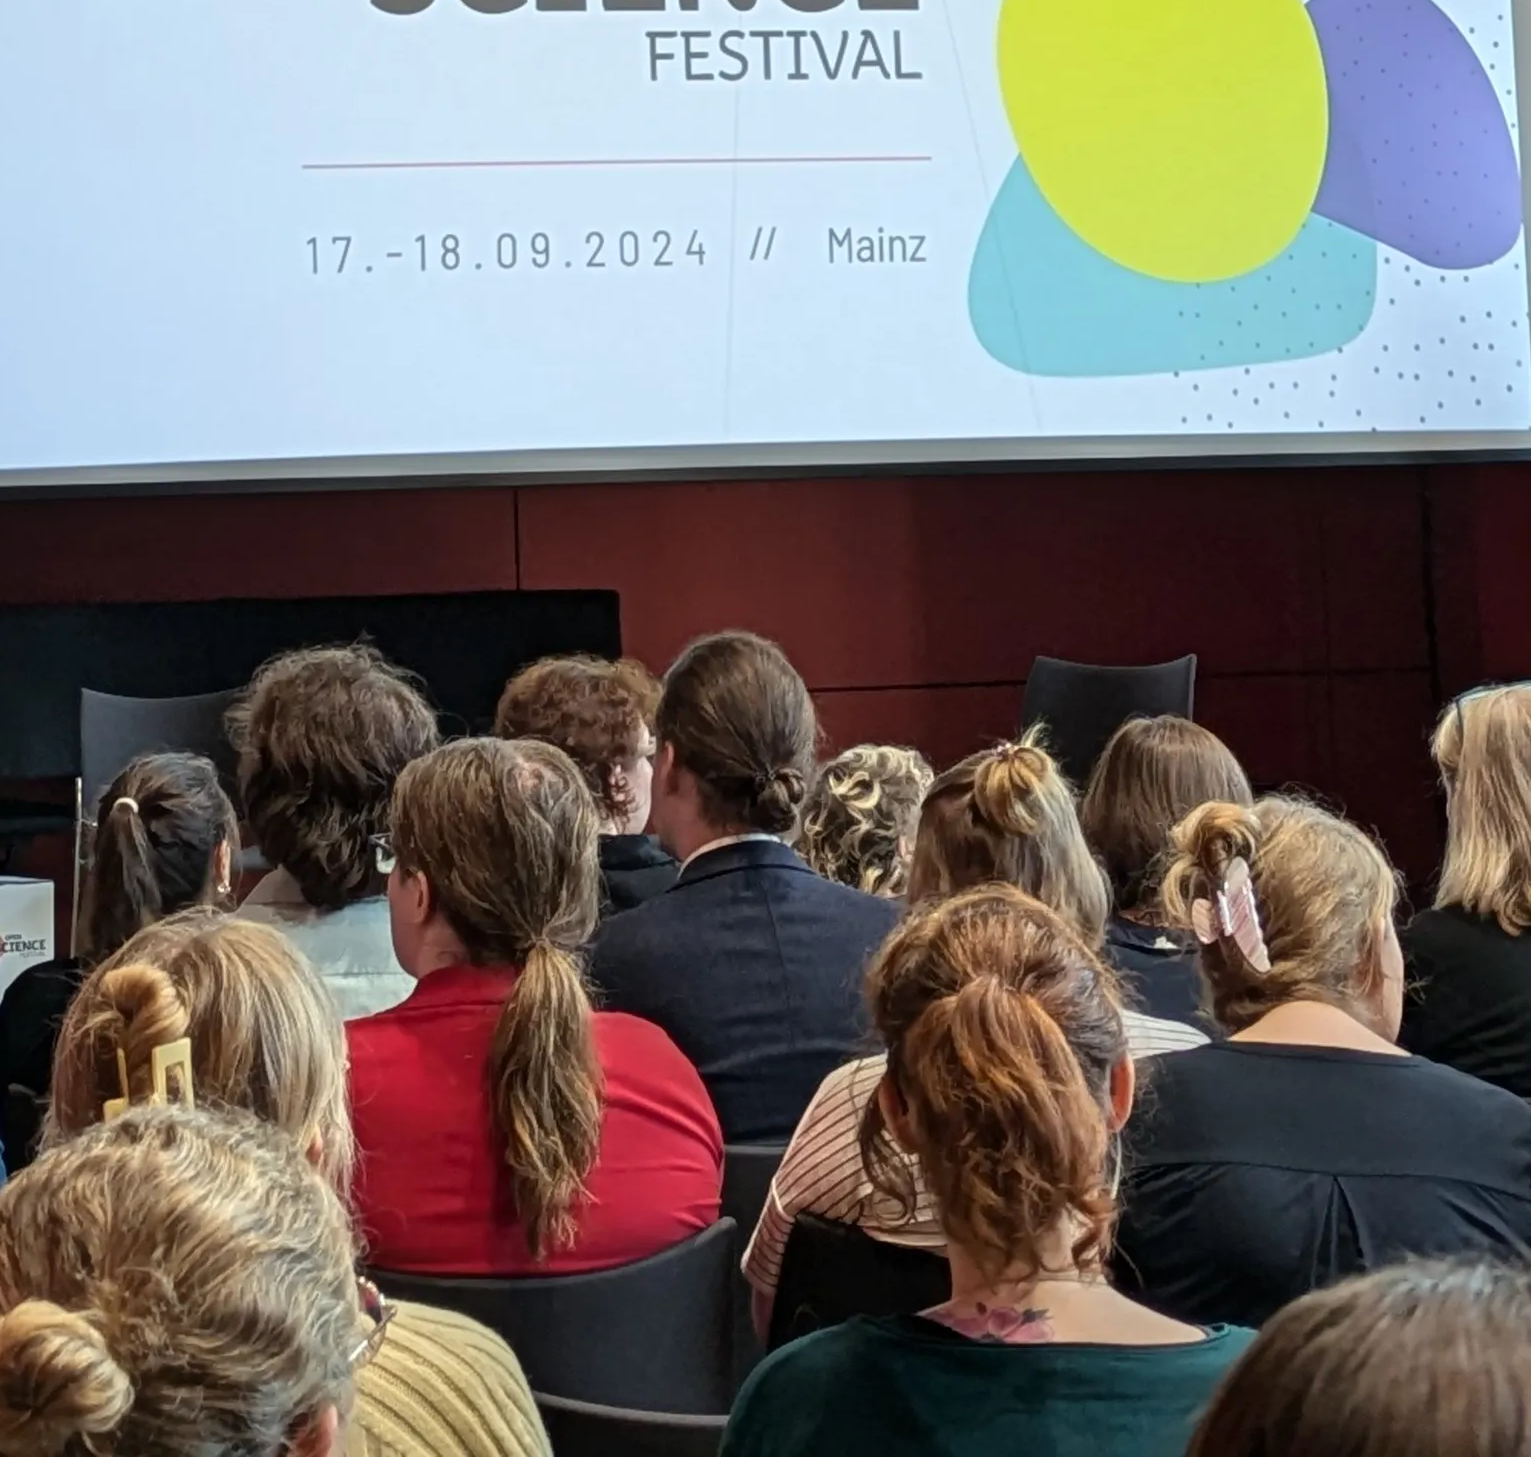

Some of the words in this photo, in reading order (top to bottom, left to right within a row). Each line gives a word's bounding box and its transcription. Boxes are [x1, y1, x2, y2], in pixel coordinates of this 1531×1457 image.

[645, 29, 924, 82] FESTIVAL
[305, 229, 708, 275] 17.-18.09.2024
[828, 226, 928, 264] Mainz
